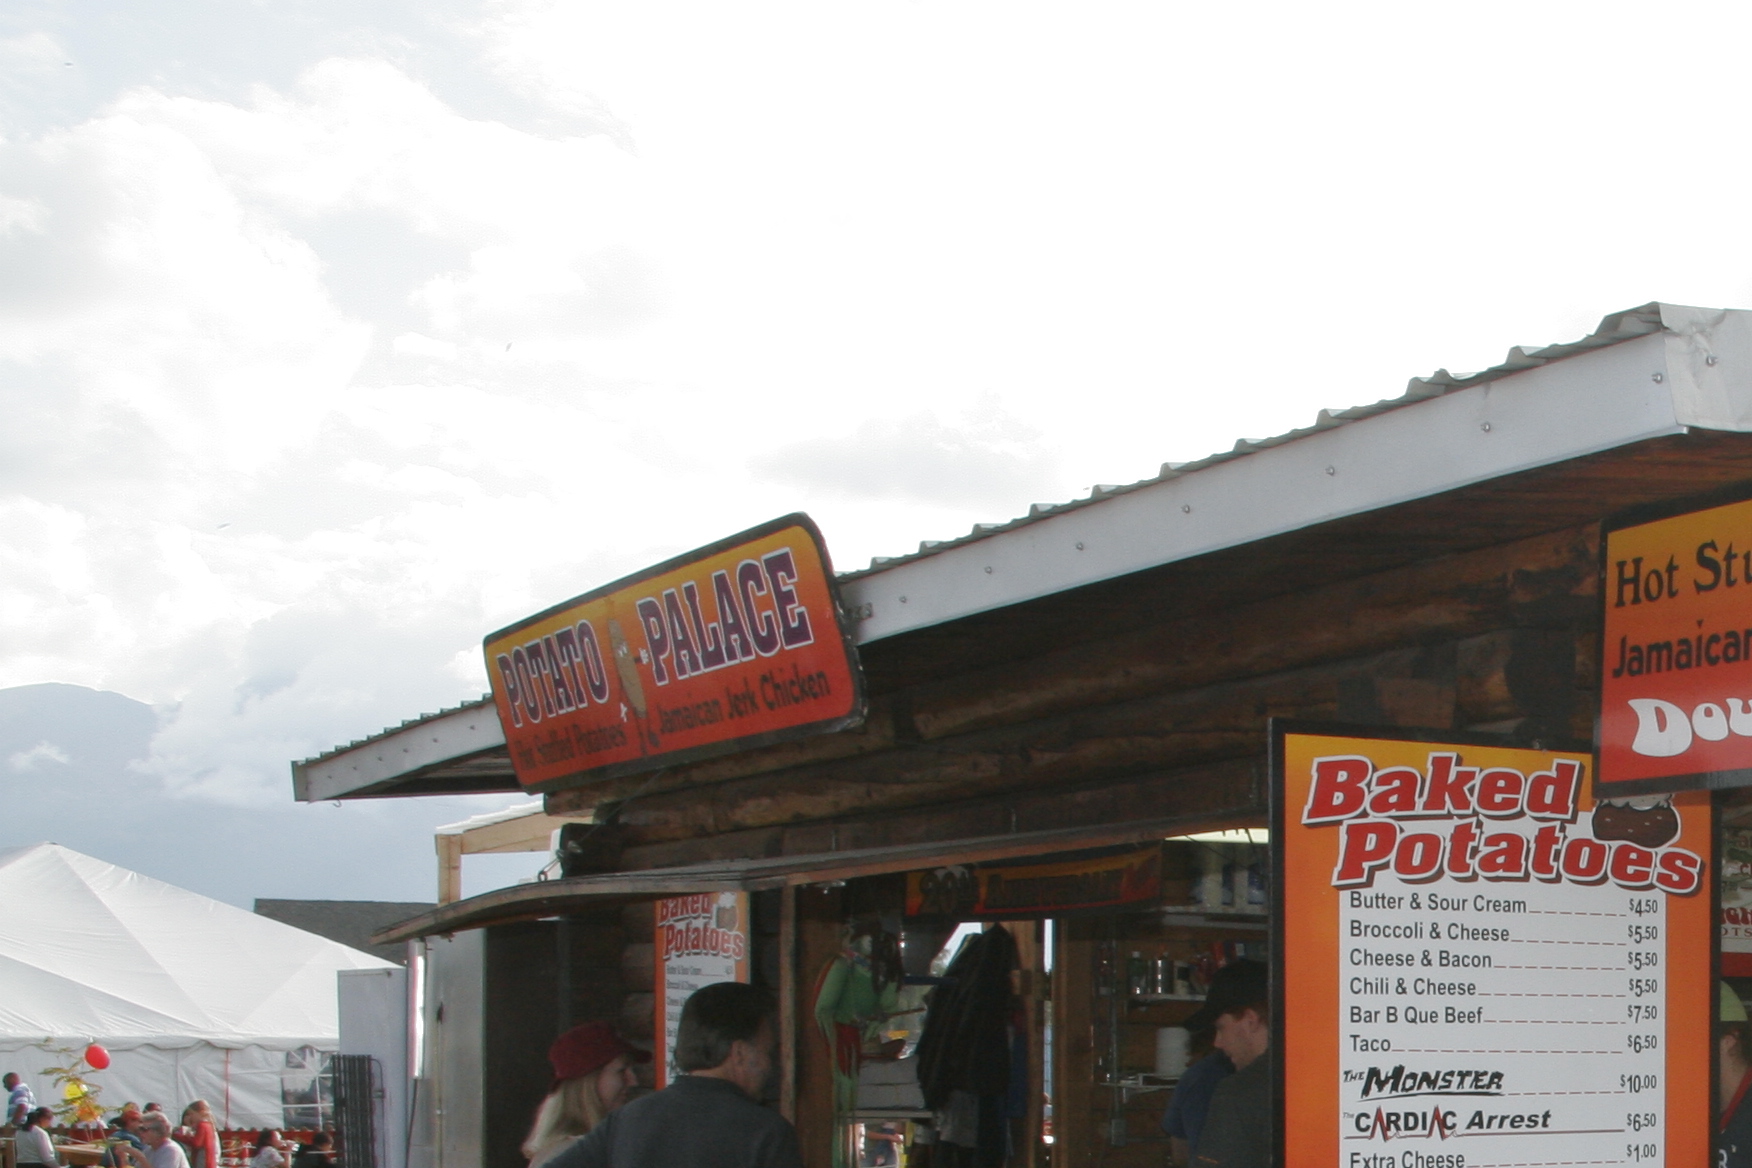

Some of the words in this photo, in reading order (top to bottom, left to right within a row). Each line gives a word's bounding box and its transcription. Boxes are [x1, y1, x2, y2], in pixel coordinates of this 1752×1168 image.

[1614, 556, 1680, 608] Hot
[497, 619, 609, 727] POTATO
[636, 547, 814, 686] PALACE
[759, 664, 831, 712] Chicken
[1302, 752, 1584, 825] Baked
[1332, 817, 1704, 894] Potatoes
[1350, 891, 1404, 912] Butter
[1409, 893, 1422, 911] &
[1428, 893, 1467, 912] Sour
[1473, 895, 1527, 914] Cream
[1629, 899, 1658, 918] $4.50
[663, 921, 744, 960] Potatoes
[1350, 920, 1423, 940] Broccoli
[1429, 922, 1441, 940] &
[1447, 923, 1510, 942] Cheese
[1628, 925, 1658, 944] $5.50
[1350, 948, 1414, 968] Cheese
[1420, 950, 1433, 967] &
[1439, 950, 1492, 969] Bacon
[1628, 952, 1658, 971] $5.50
[1350, 977, 1389, 996] Chili
[1394, 978, 1407, 996] &
[1413, 978, 1476, 996] Cheese
[1629, 978, 1658, 998] $5.50
[1350, 1006, 1380, 1024] Bar
[1386, 1006, 1398, 1024] B
[1404, 1006, 1439, 1026] Que
[1445, 1006, 1483, 1024] Beef
[1627, 1005, 1658, 1025] $7.50
[1350, 1035, 1391, 1053] Taco
[1627, 1035, 1658, 1054] $6.50
[1361, 1064, 1504, 1099] MONSTER
[1619, 1074, 1657, 1095] $10.00
[1355, 1105, 1457, 1142] CARDIAC
[1466, 1109, 1552, 1131] Arrest
[1626, 1112, 1657, 1130] $6.50
[1626, 1143, 1657, 1161] $1.00
